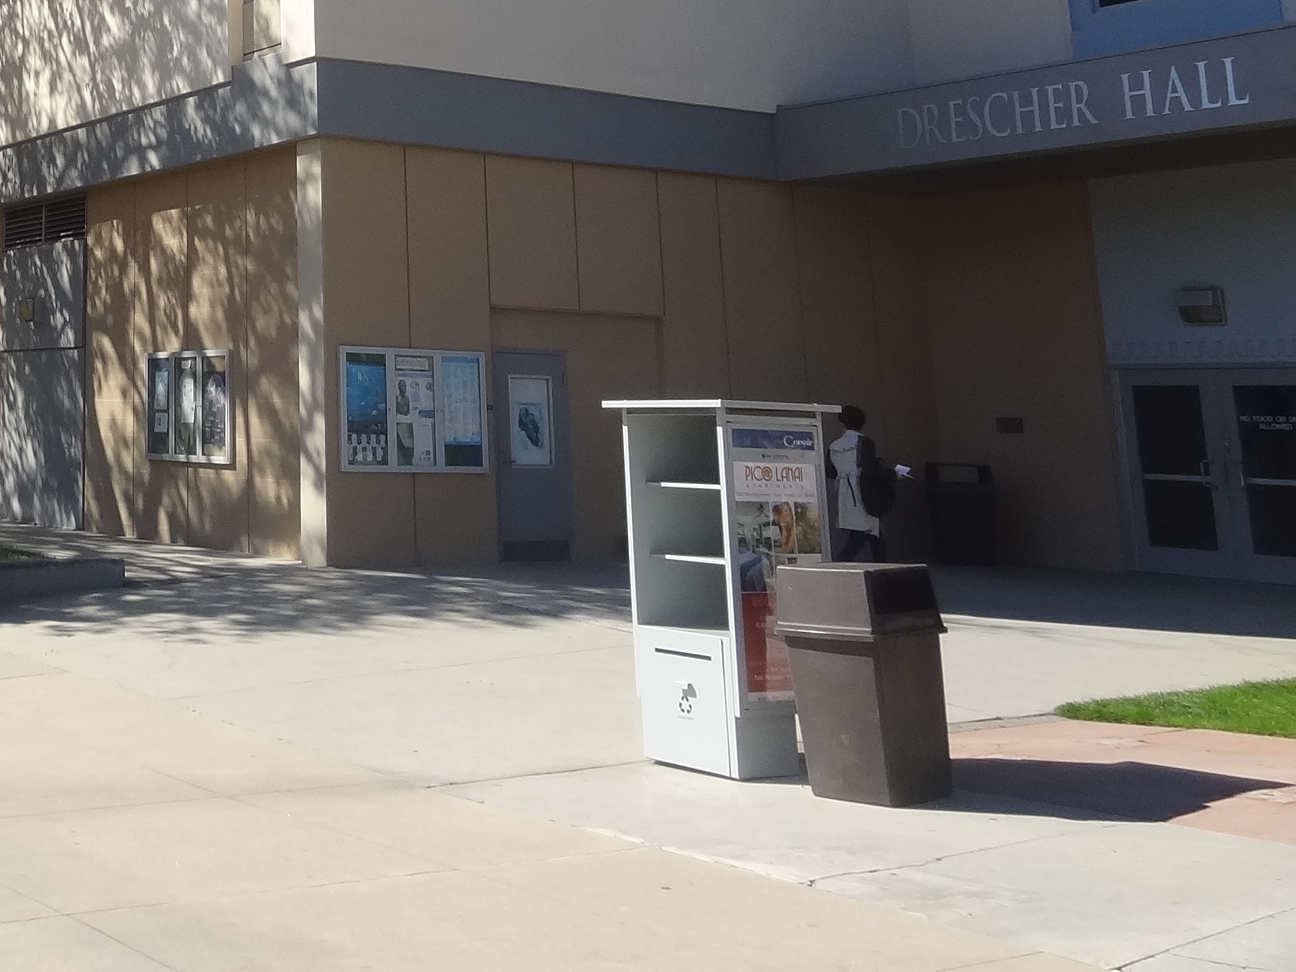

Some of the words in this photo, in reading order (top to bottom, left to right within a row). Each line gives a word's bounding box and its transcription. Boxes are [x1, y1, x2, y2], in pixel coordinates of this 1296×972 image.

[895, 79, 1100, 151] DRESCHER
[1119, 56, 1250, 120] HALL
[1252, 415, 1273, 423] FOOD
[1275, 415, 1287, 423] OR
[783, 435, 814, 448] Corsair
[744, 465, 773, 482] PICO
[775, 466, 804, 483] LANAI
